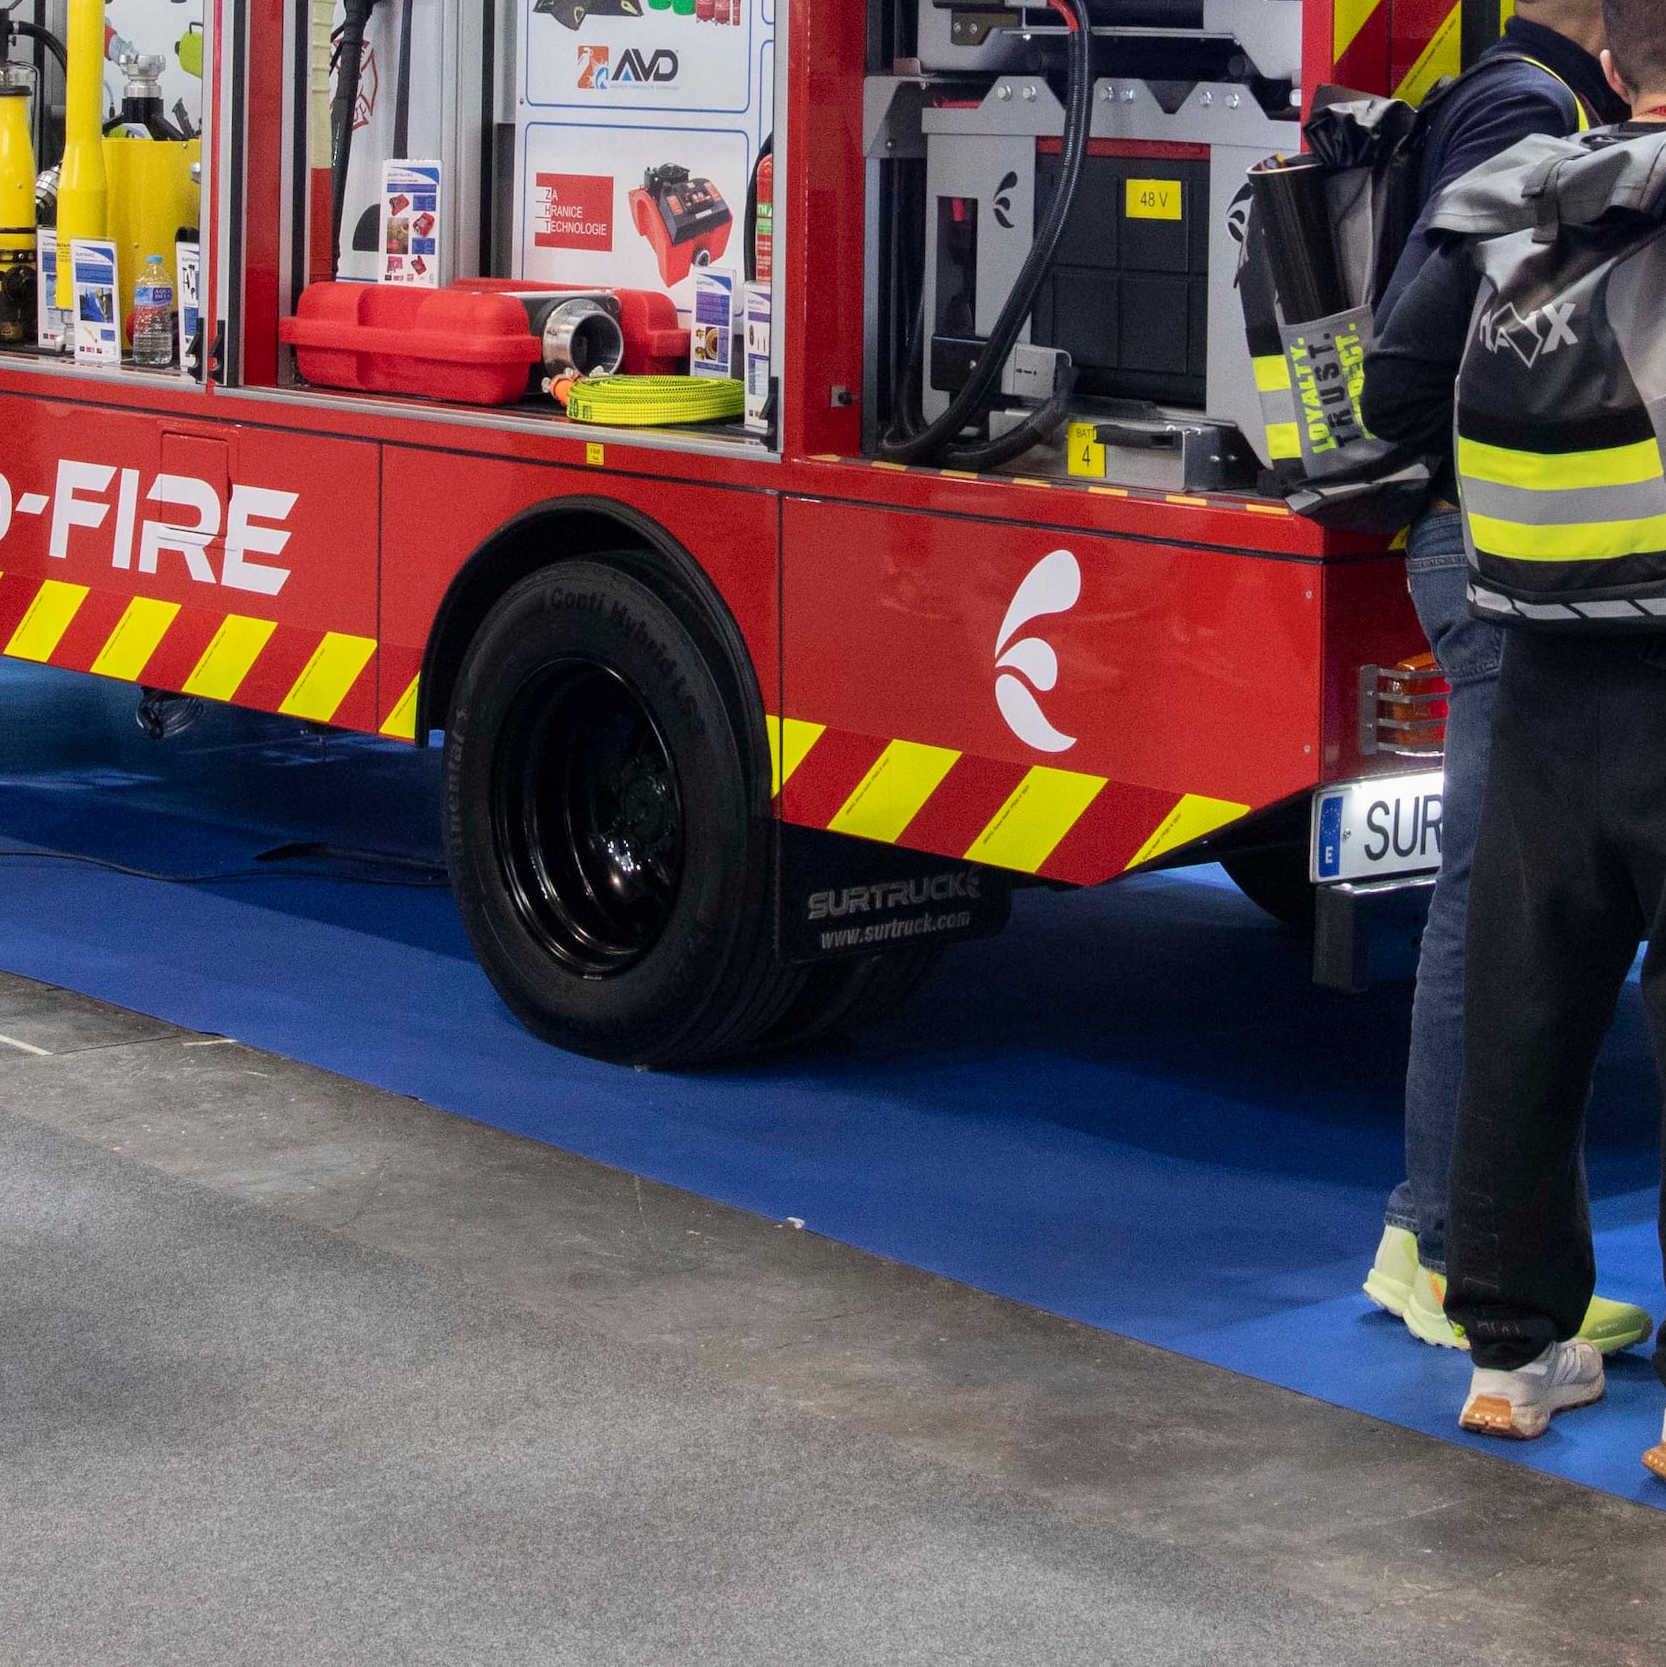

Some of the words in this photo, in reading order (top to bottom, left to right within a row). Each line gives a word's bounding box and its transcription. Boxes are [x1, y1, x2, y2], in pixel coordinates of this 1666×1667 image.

[611, 48, 679, 82] AVD
[545, 188, 559, 201] ZA
[1140, 191, 1157, 209] 48
[1158, 192, 1168, 209] V
[545, 205, 583, 218] HRANICE
[545, 221, 607, 236] TECHNOLOGIE
[1290, 337, 1337, 454] LOYALTY.
[1081, 444, 1092, 468] 4
[1324, 845, 1334, 864] E
[808, 870, 966, 920] SURTRUCK
[820, 910, 971, 949] www.surtruck.com
